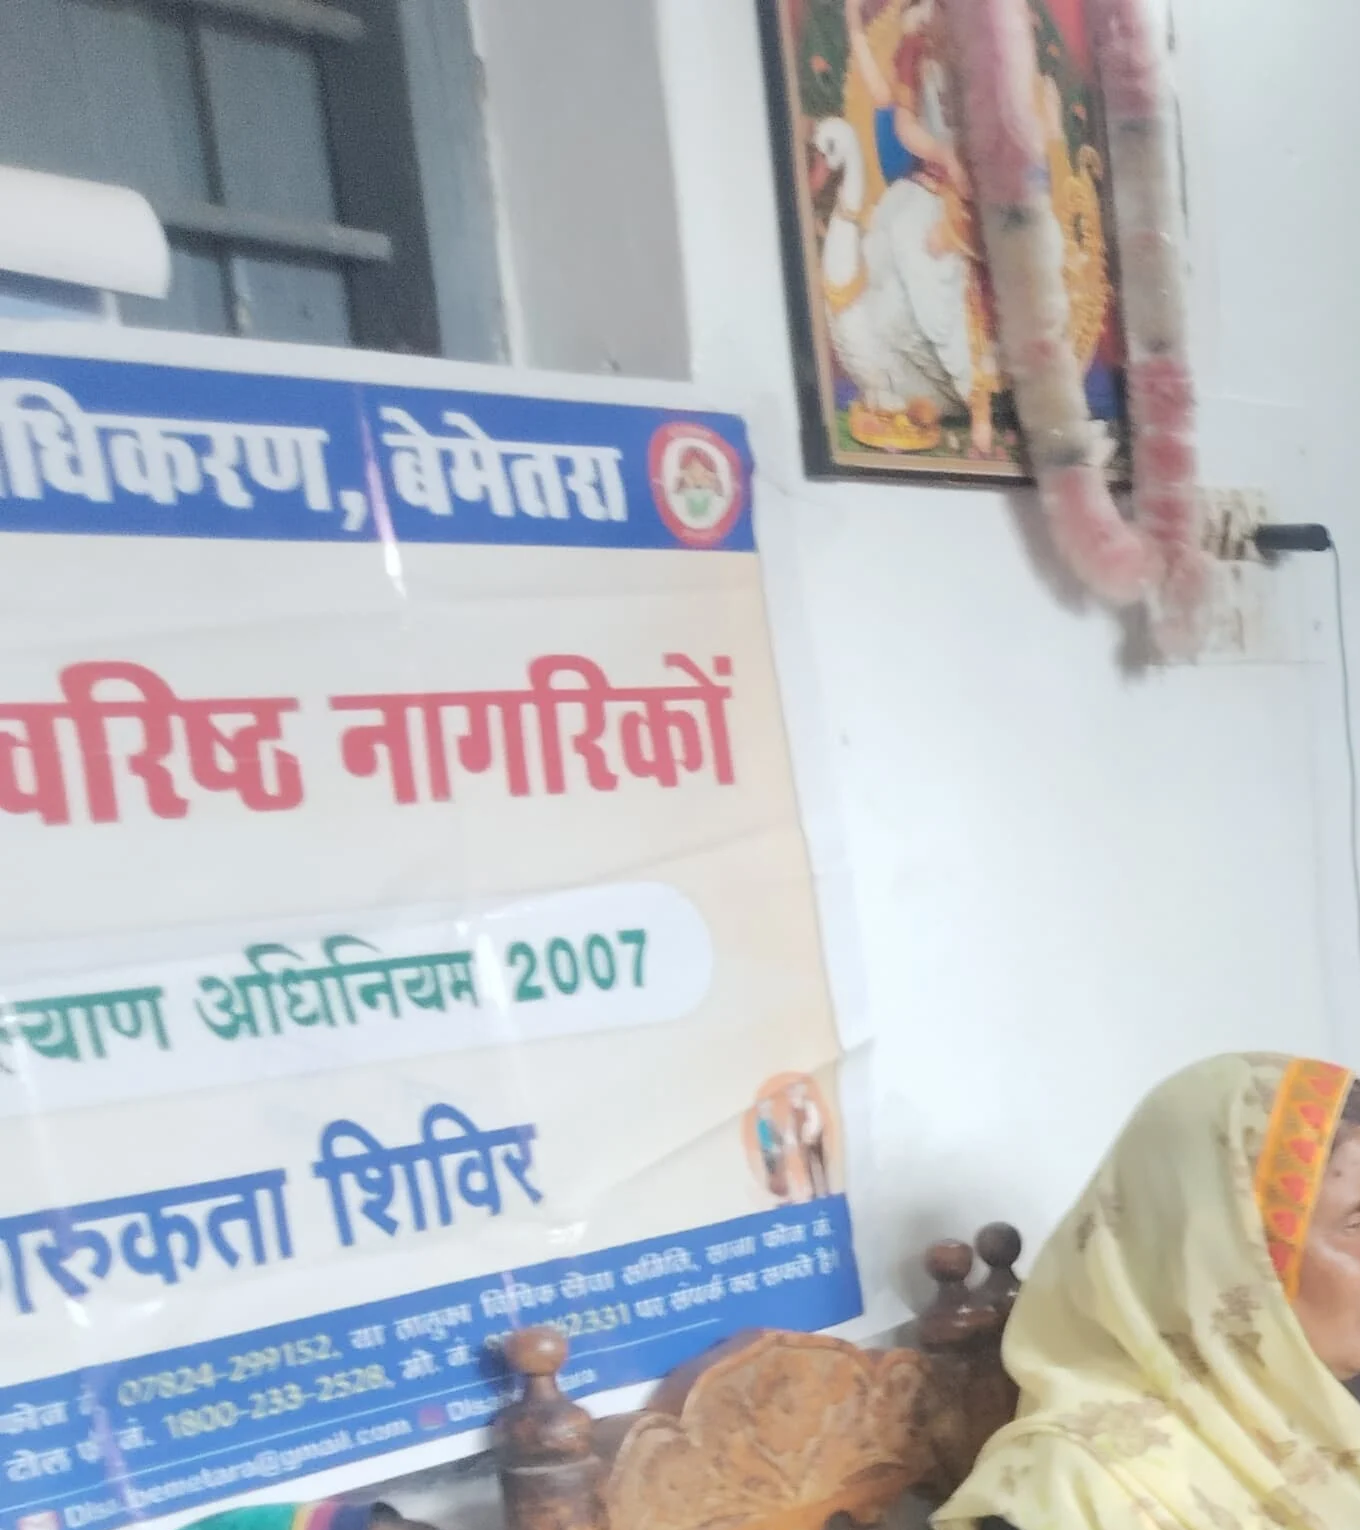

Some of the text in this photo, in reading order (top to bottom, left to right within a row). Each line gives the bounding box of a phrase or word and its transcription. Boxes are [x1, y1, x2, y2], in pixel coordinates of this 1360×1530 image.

[0, 377, 628, 531] धिकरण, बेमेतरा
[329, 653, 735, 804] नागरिकों
[195, 935, 480, 1040] अधिनियम
[507, 929, 648, 1003] 2007
[312, 1102, 544, 1247] शिविर
